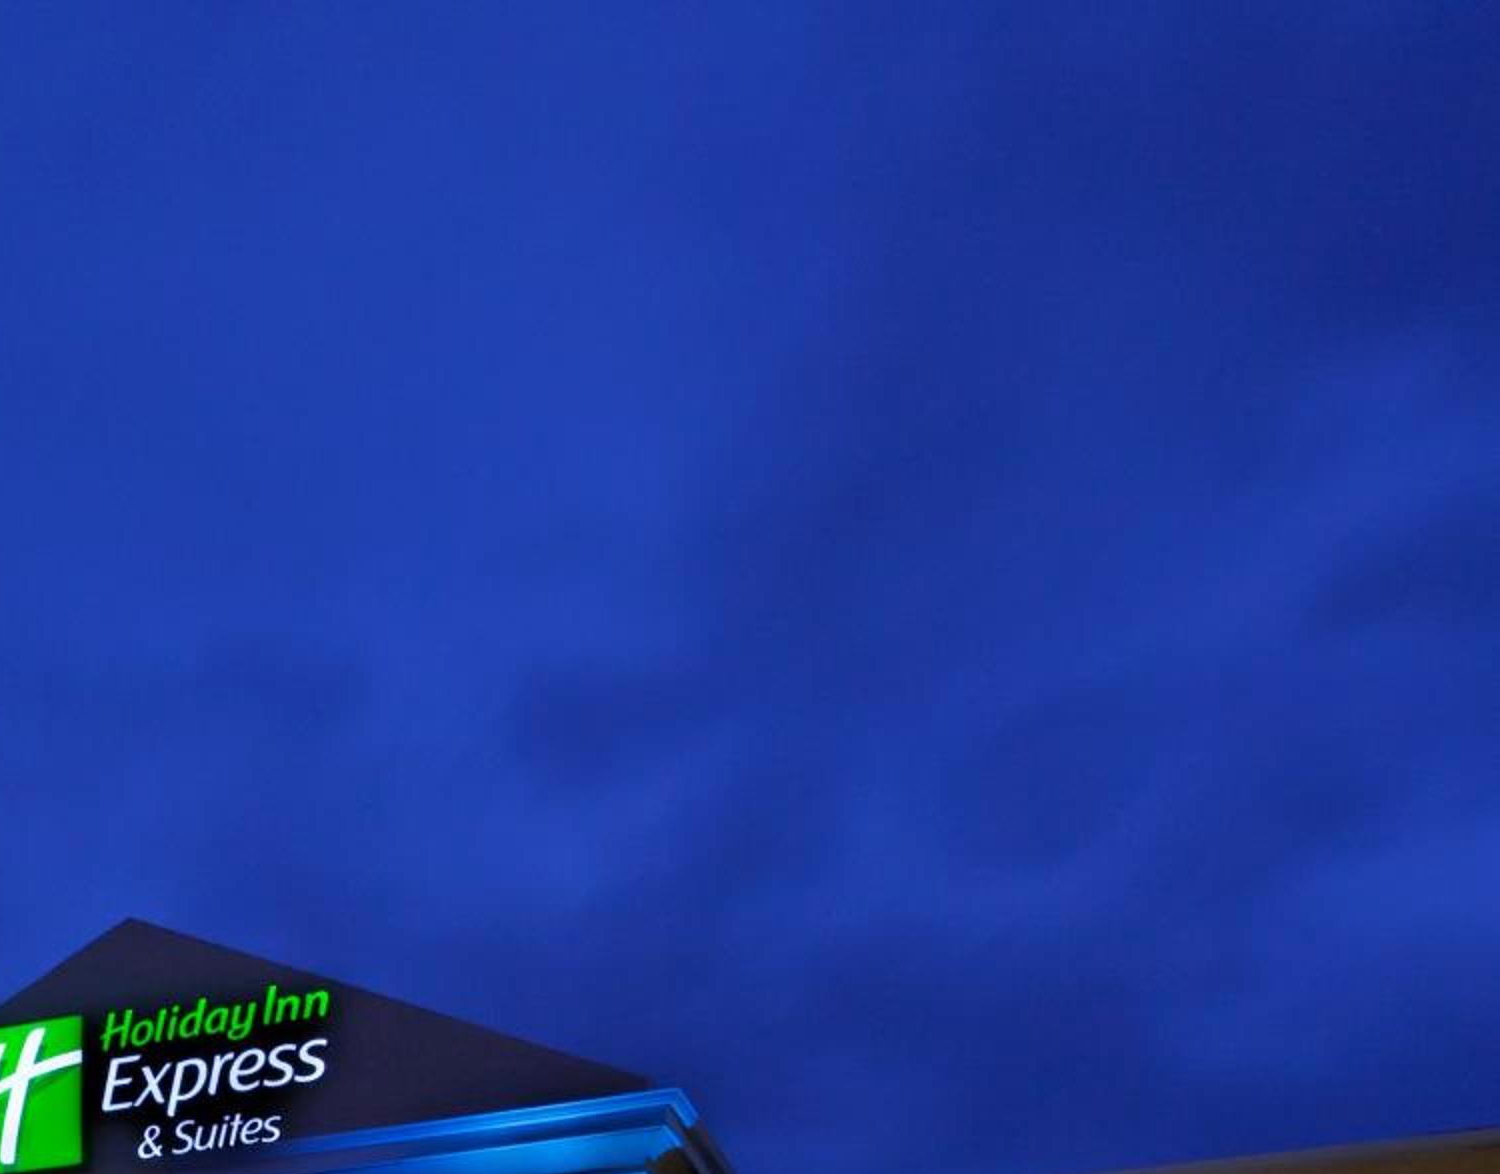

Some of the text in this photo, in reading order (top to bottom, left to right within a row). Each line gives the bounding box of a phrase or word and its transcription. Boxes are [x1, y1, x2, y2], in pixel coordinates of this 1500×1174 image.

[100, 985, 330, 1053] Holiday Inn
[101, 1038, 328, 1117] Express
[137, 1113, 282, 1160] & Suites
